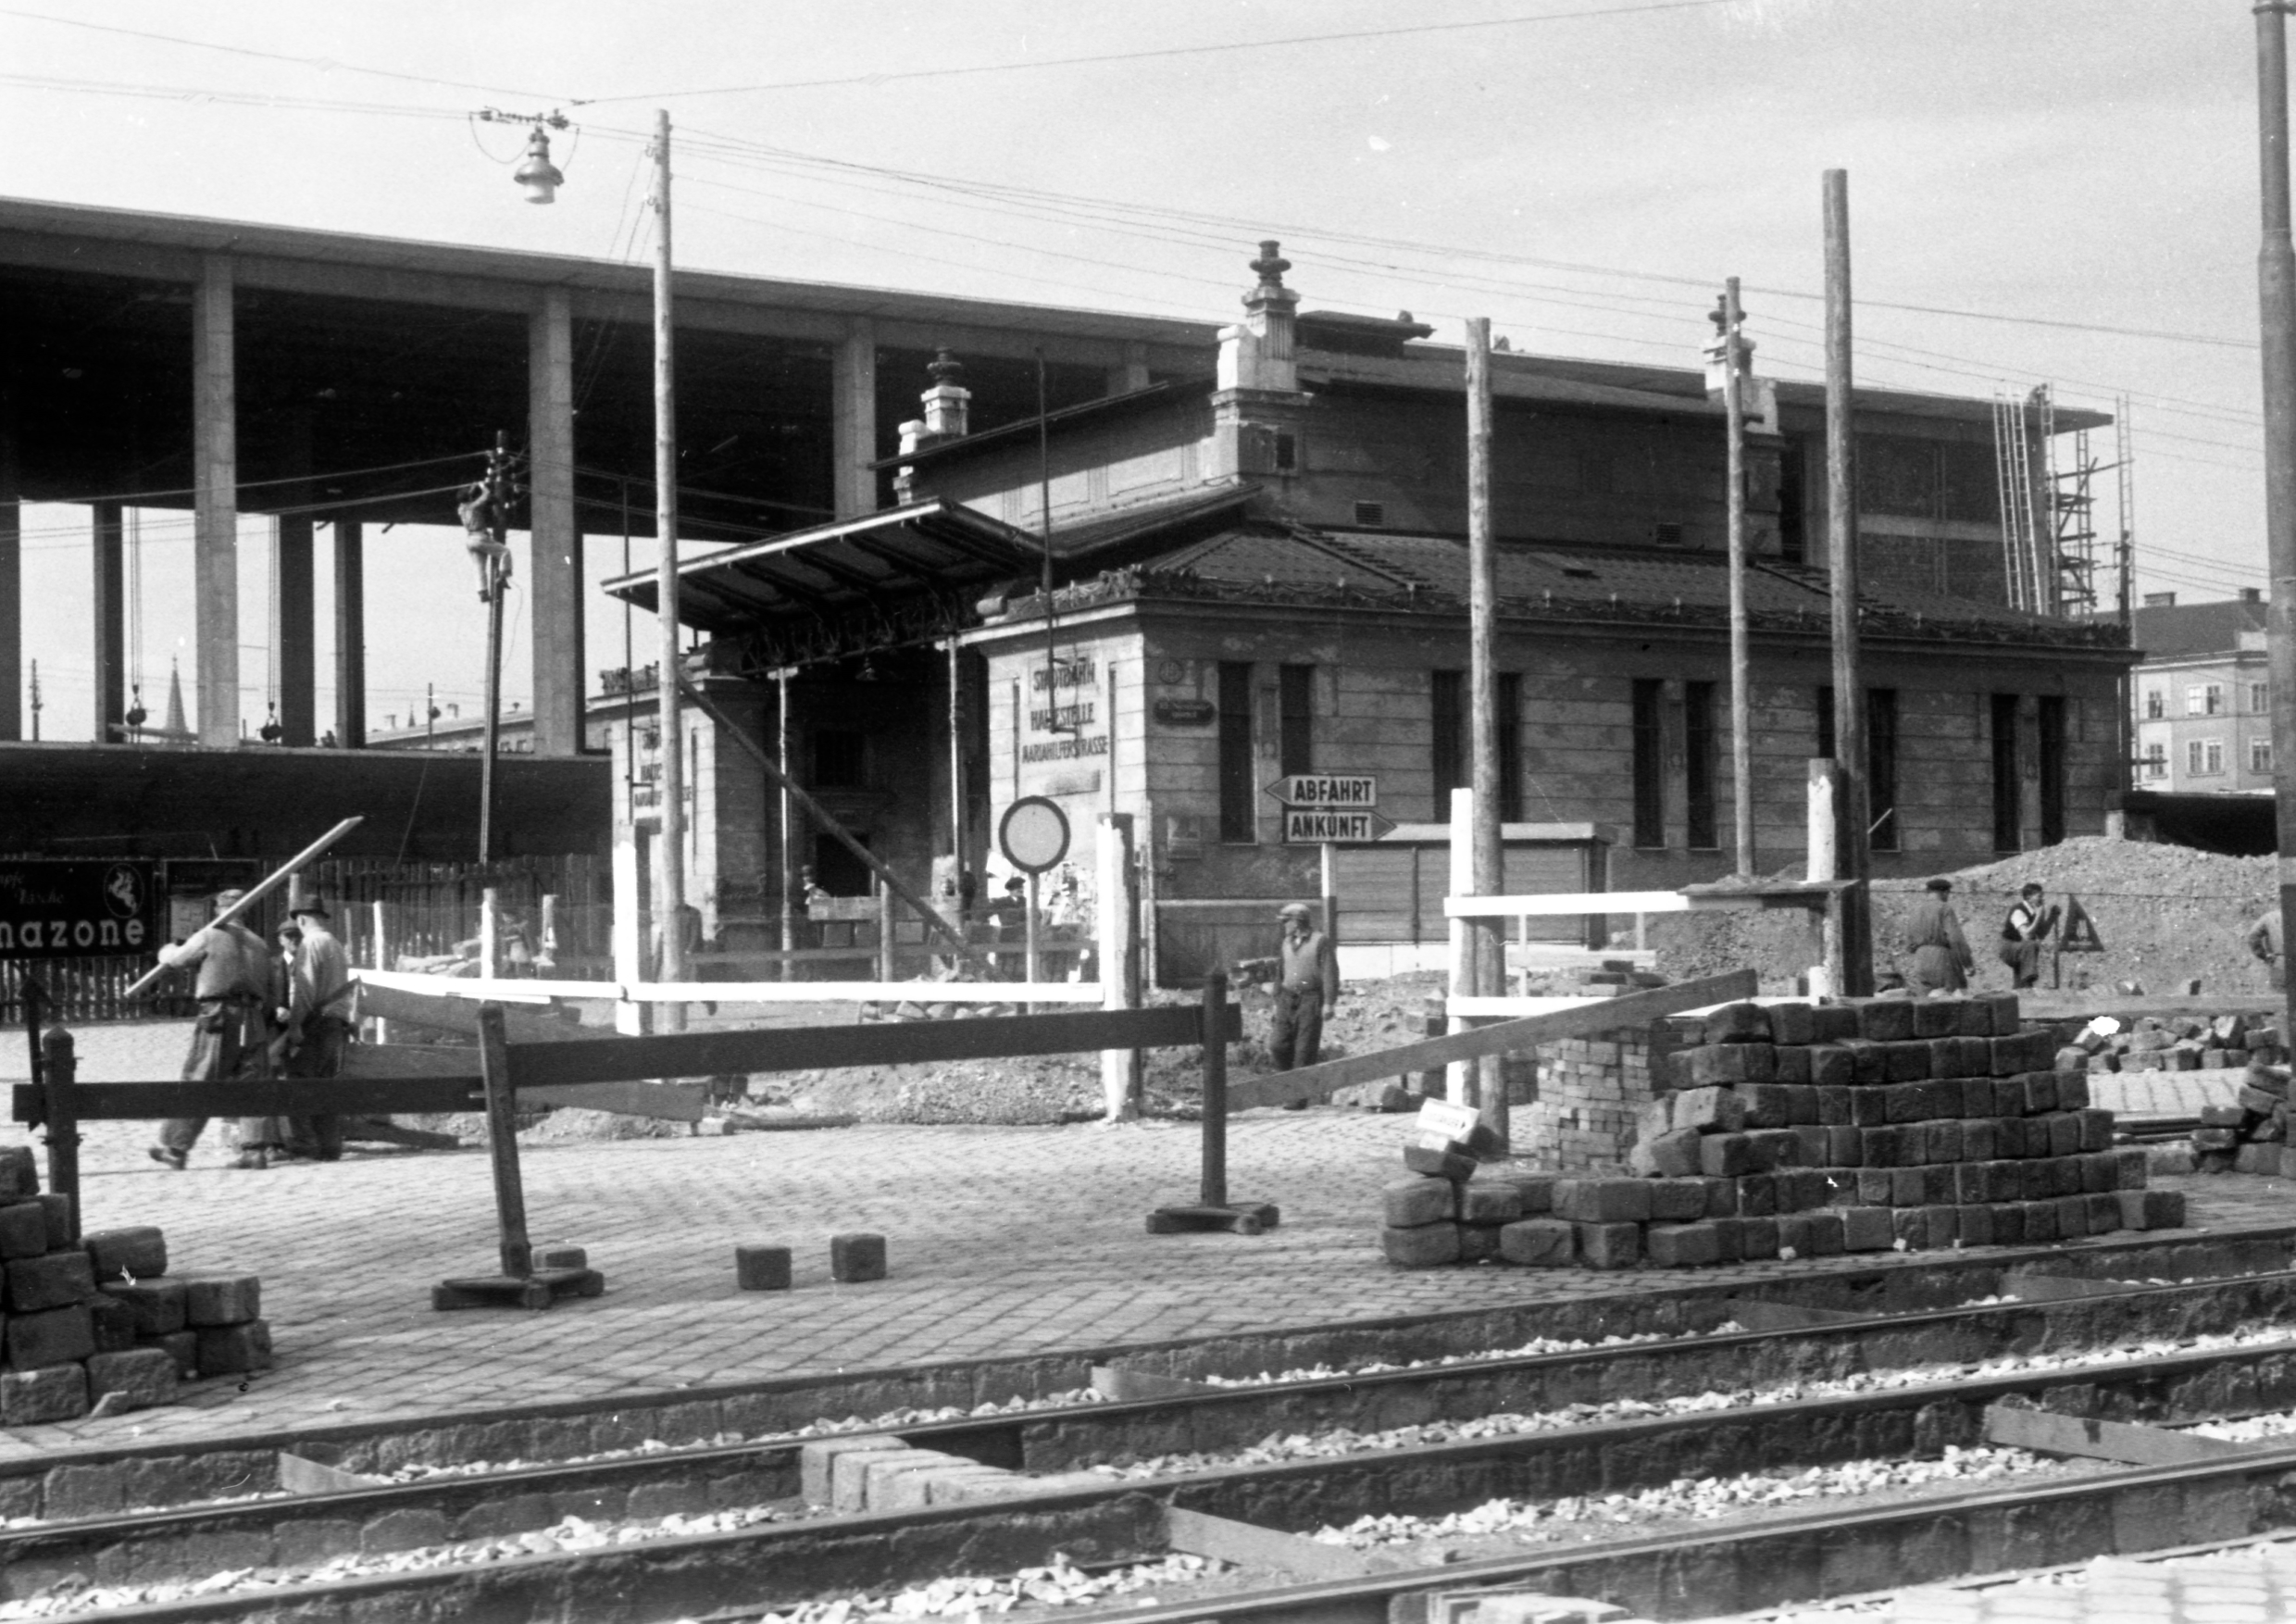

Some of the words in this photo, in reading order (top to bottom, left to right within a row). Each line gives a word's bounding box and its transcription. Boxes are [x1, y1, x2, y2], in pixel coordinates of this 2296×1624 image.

[1030, 703, 1094, 731] HALESTELLE
[1294, 780, 1371, 802] ABFAHRT
[1292, 815, 1367, 837] ANKUNFT
